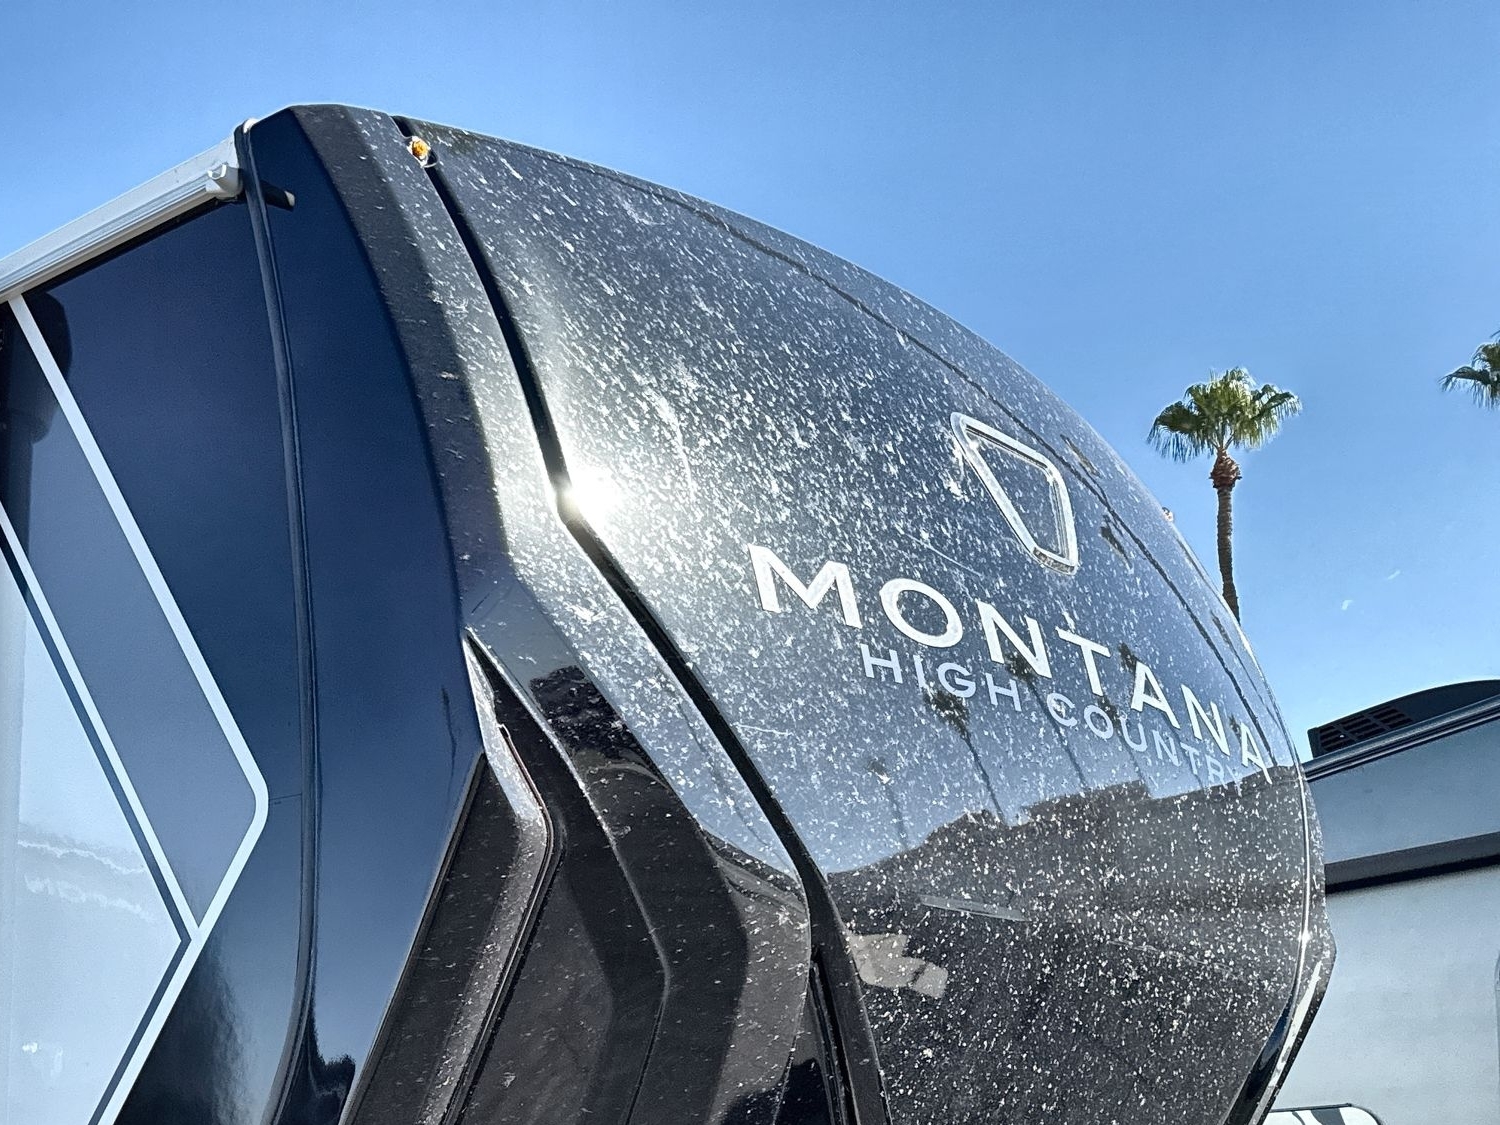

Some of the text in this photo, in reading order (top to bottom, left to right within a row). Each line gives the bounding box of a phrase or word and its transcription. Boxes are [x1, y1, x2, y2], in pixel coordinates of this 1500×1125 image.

[747, 543, 1271, 785] MONTANA
[861, 643, 1241, 797] HIGH COUNTRY
